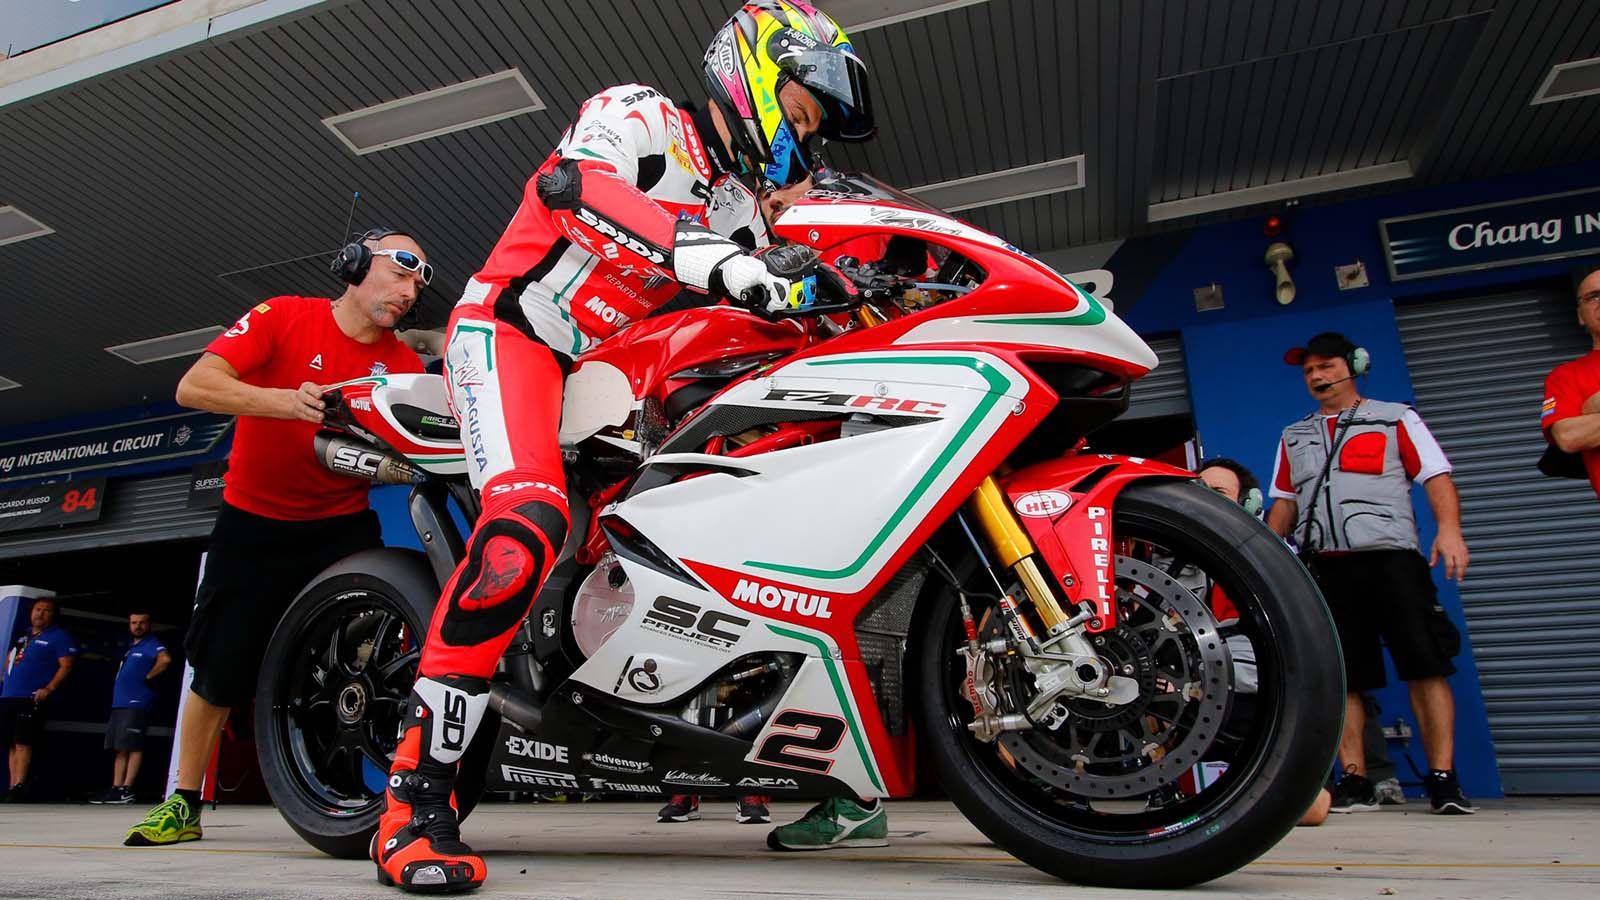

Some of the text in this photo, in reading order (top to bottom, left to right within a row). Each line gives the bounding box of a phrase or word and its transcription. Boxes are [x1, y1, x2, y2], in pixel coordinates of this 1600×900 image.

[575, 207, 665, 264] SPIDI
[1448, 218, 1562, 251] Chang
[604, 273, 637, 299] REPARTO
[17, 442, 109, 467] INTERNATIONAL
[112, 433, 164, 453] CIRCUIT
[465, 396, 489, 473] AGUSTA
[333, 447, 385, 472] SC
[26, 496, 51, 506] RUSSO
[61, 488, 97, 513] 84
[1025, 500, 1063, 513] HEL
[1087, 506, 1110, 616] PIRELLI
[731, 578, 833, 619] MOTUL
[641, 617, 736, 648] PROJECT
[645, 595, 751, 643] SC
[966, 670, 983, 715] brembo
[441, 690, 467, 751] SIDI
[505, 735, 569, 764] EXIDE
[753, 708, 848, 775] 2
[500, 763, 580, 789] PIRELLI
[604, 782, 663, 794] TSUBAKI
